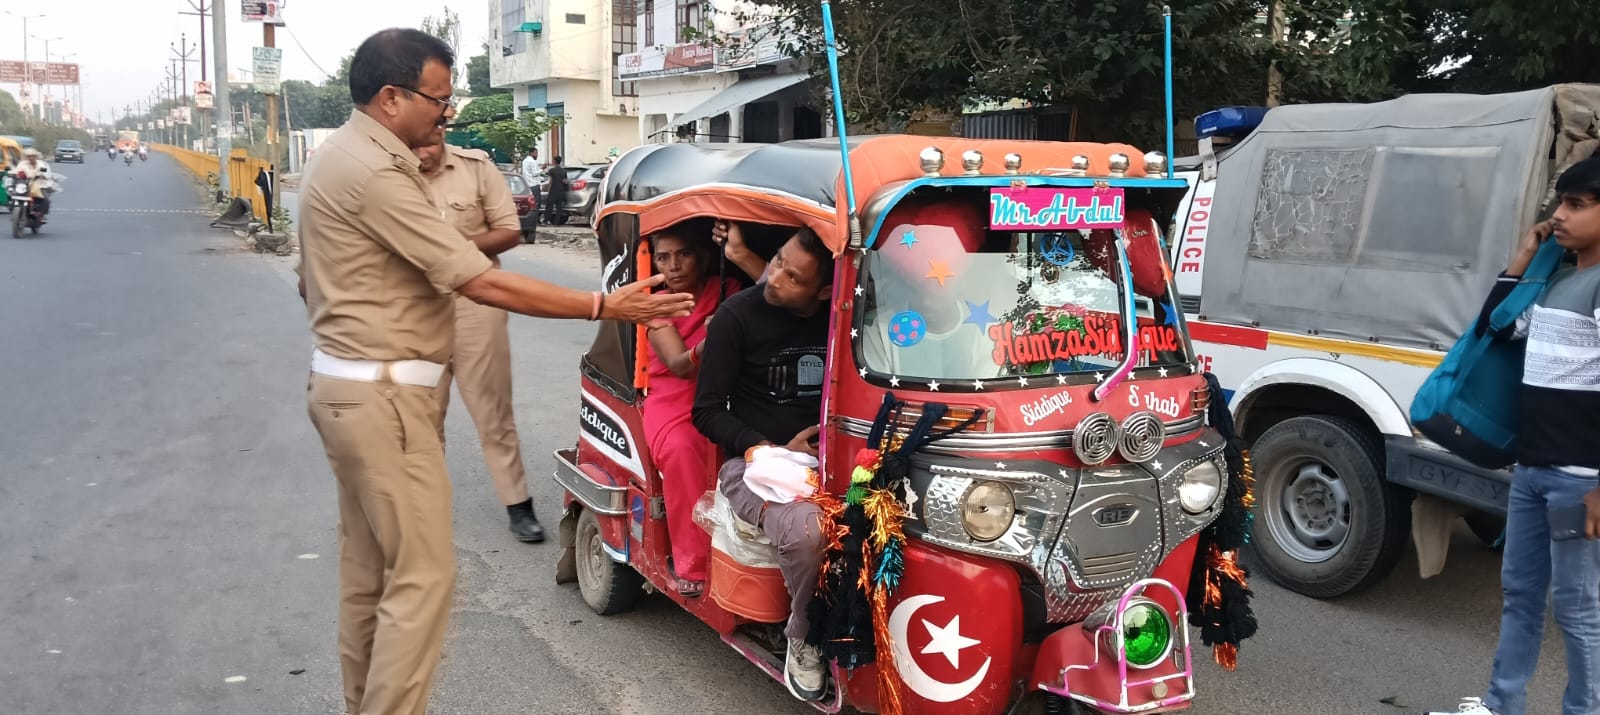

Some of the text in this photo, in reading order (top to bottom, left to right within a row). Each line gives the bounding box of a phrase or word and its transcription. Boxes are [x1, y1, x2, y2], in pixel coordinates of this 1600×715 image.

[991, 193, 1124, 226] Mr.Abdul
[1181, 197, 1212, 273] POLICE
[580, 406, 626, 449] ddique
[1020, 390, 1073, 426] Siddique
